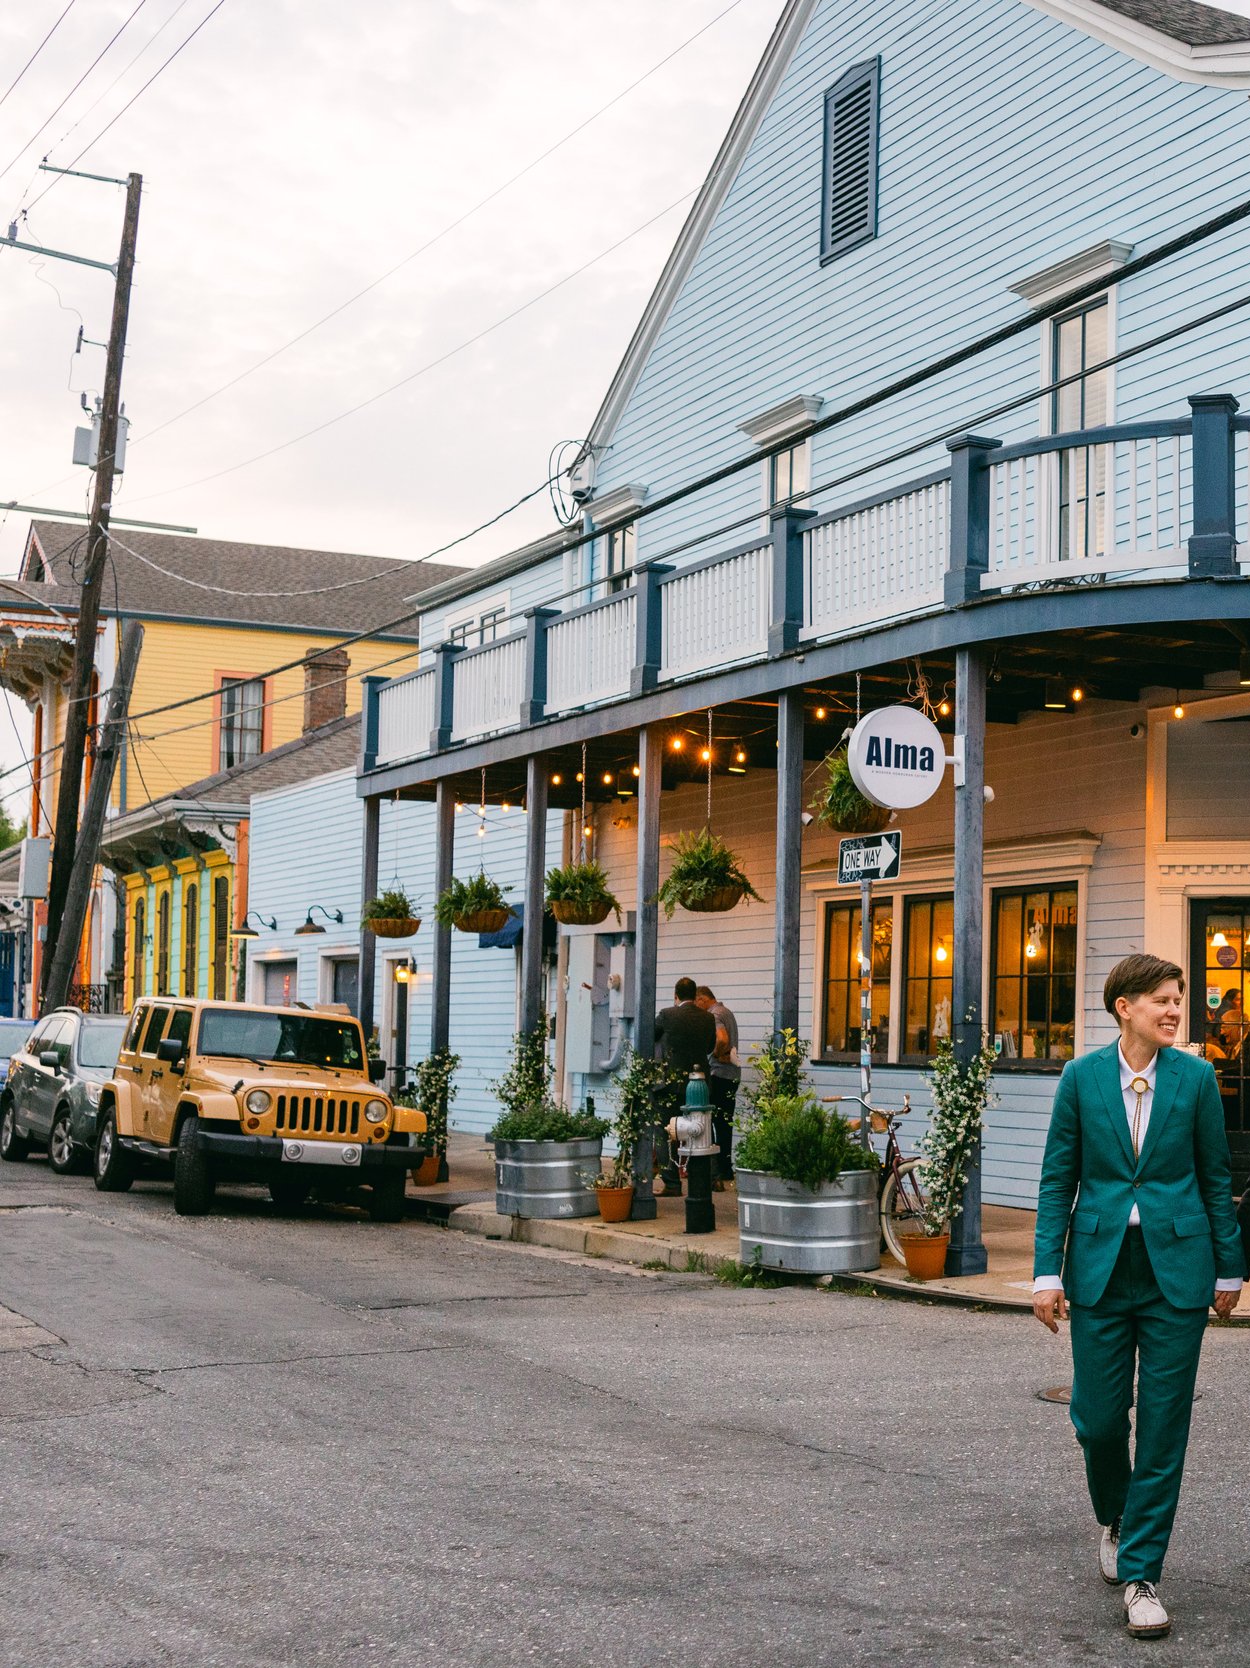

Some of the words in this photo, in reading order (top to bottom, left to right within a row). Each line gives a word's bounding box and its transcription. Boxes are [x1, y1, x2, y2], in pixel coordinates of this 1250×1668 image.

[866, 736, 934, 772] Alma
[845, 852, 861, 869] ONE
[863, 848, 882, 867] WAY
[1033, 906, 1077, 924] Alma
